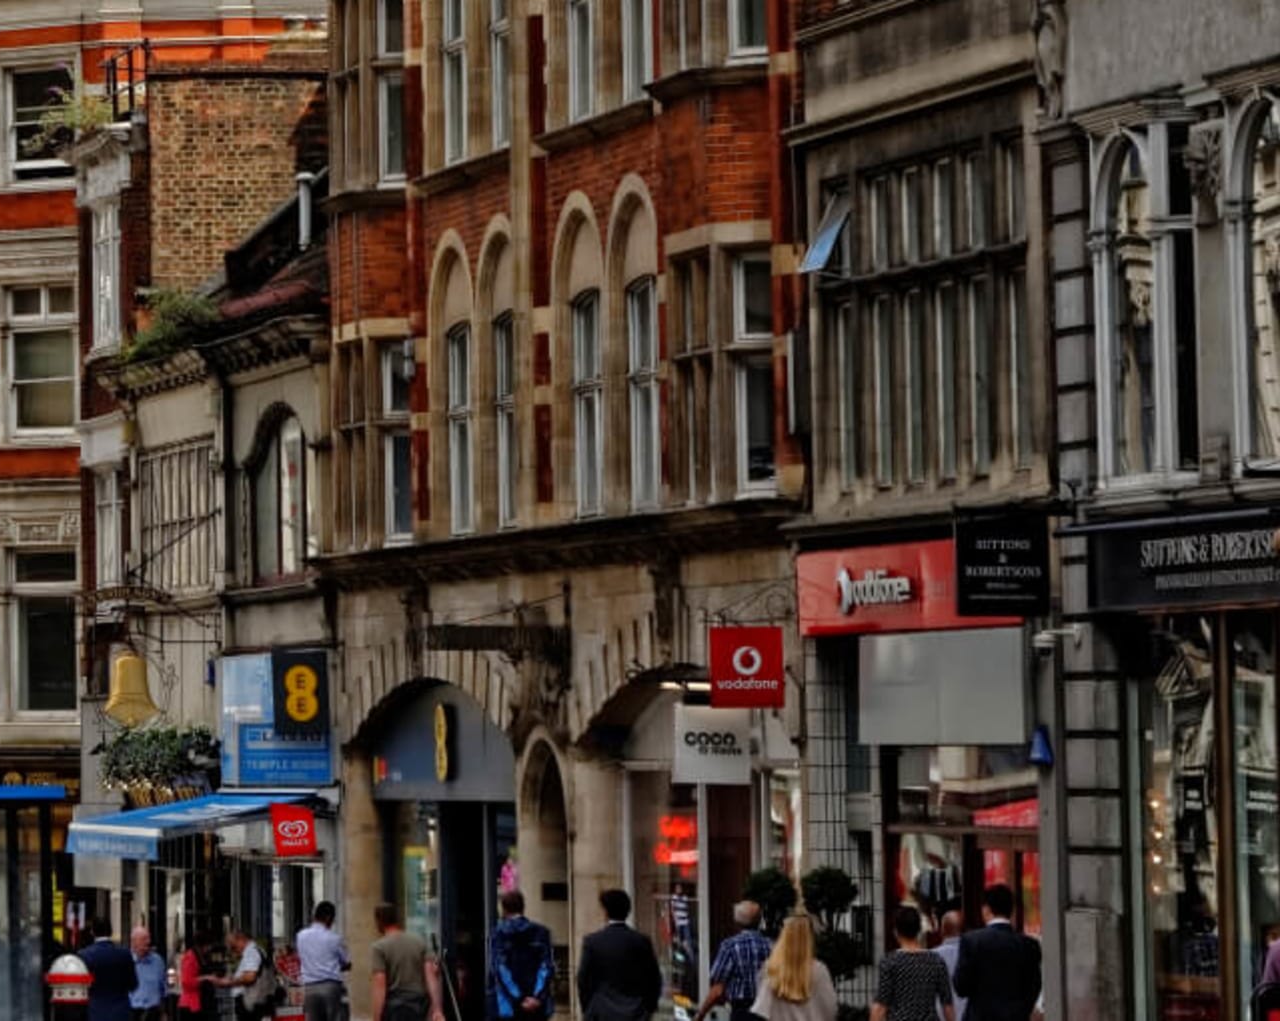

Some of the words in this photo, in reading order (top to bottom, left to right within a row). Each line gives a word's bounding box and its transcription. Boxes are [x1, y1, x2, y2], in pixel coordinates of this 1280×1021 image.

[975, 540, 1031, 550] SUTTONS
[1140, 536, 1198, 568] SUTTONS
[1200, 534, 1209, 562] &
[965, 566, 1042, 576] ROBERTSONS
[717, 678, 778, 689] vodafone
